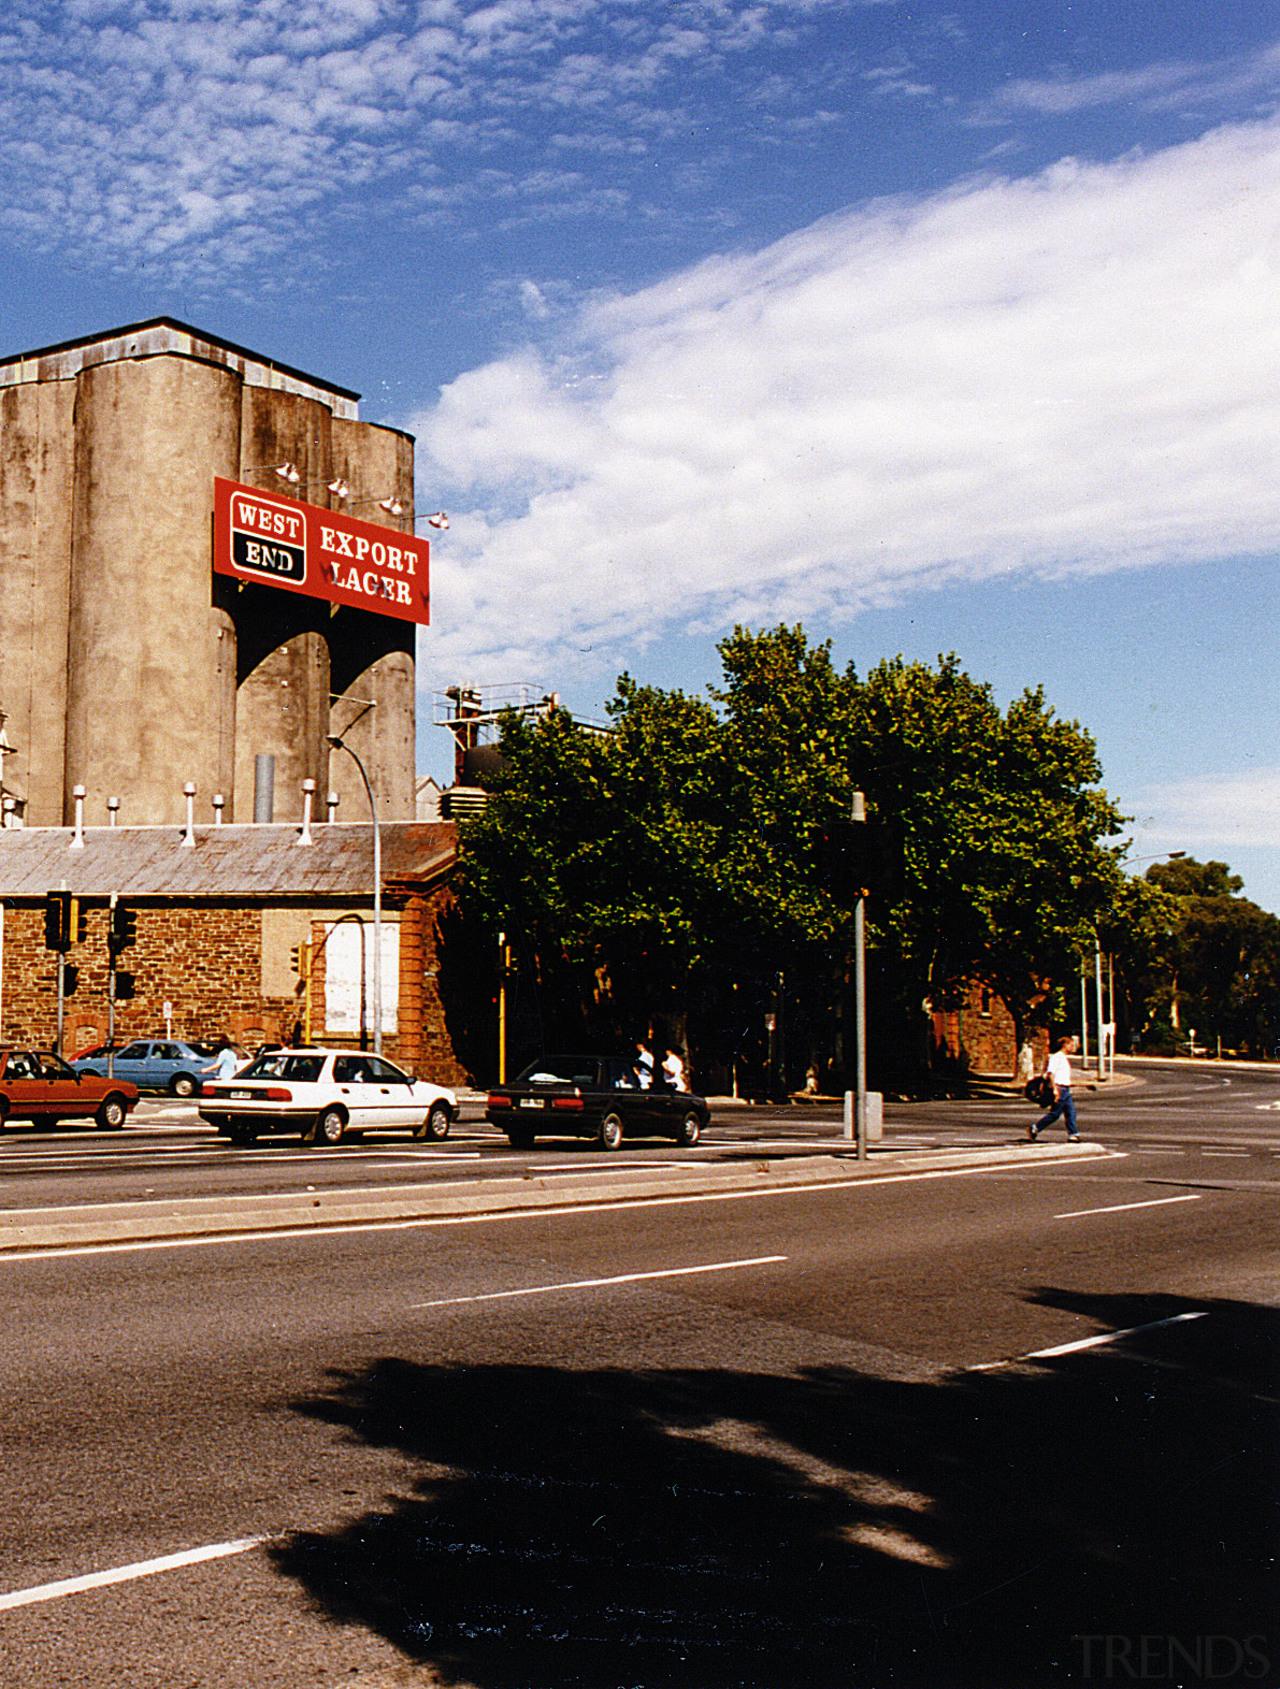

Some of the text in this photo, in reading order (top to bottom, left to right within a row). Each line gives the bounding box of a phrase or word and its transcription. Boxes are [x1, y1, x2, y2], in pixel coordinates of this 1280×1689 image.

[238, 502, 300, 538] WEST
[245, 541, 294, 572] END
[320, 526, 418, 575] EXPORT
[330, 561, 413, 605] LAGER
